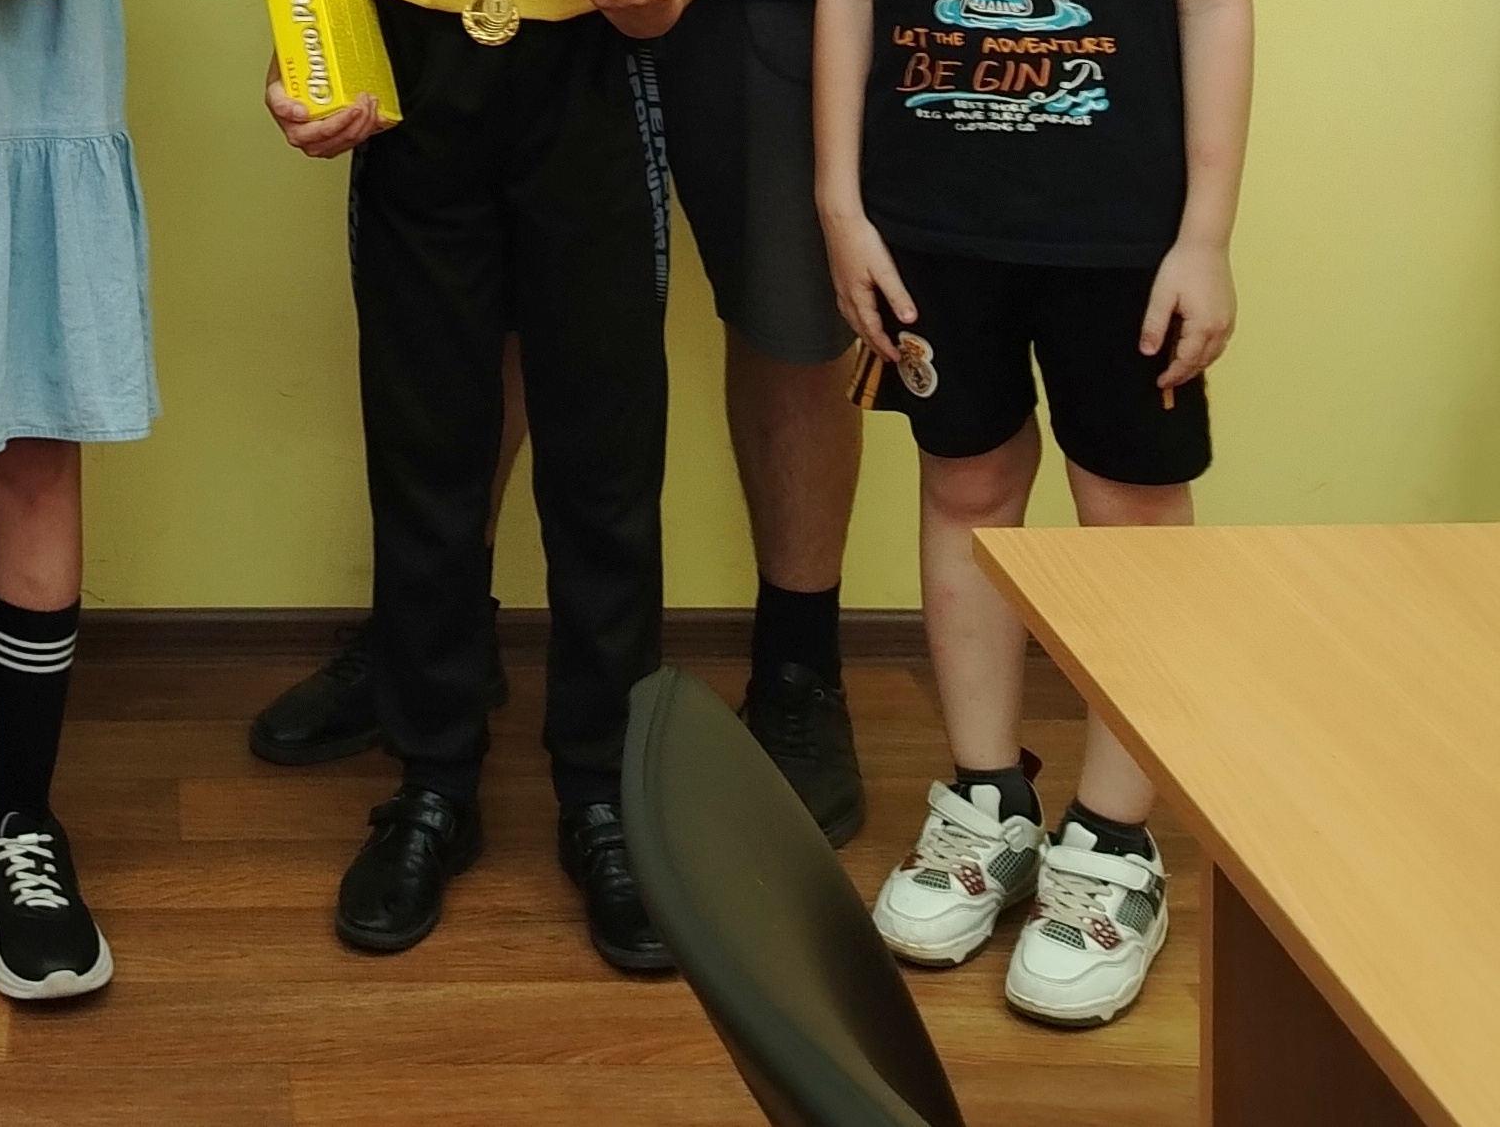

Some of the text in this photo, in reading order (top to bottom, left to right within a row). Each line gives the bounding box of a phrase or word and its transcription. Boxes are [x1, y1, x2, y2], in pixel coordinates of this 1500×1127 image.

[930, 31, 967, 47] THE
[980, 36, 1118, 55] ADVENTURE
[302, 26, 334, 106] Choco
[895, 52, 1052, 93] BE GIN
[915, 108, 943, 120] BIG
[944, 110, 987, 121] WAVE
[1027, 112, 1094, 126] GARAGE
